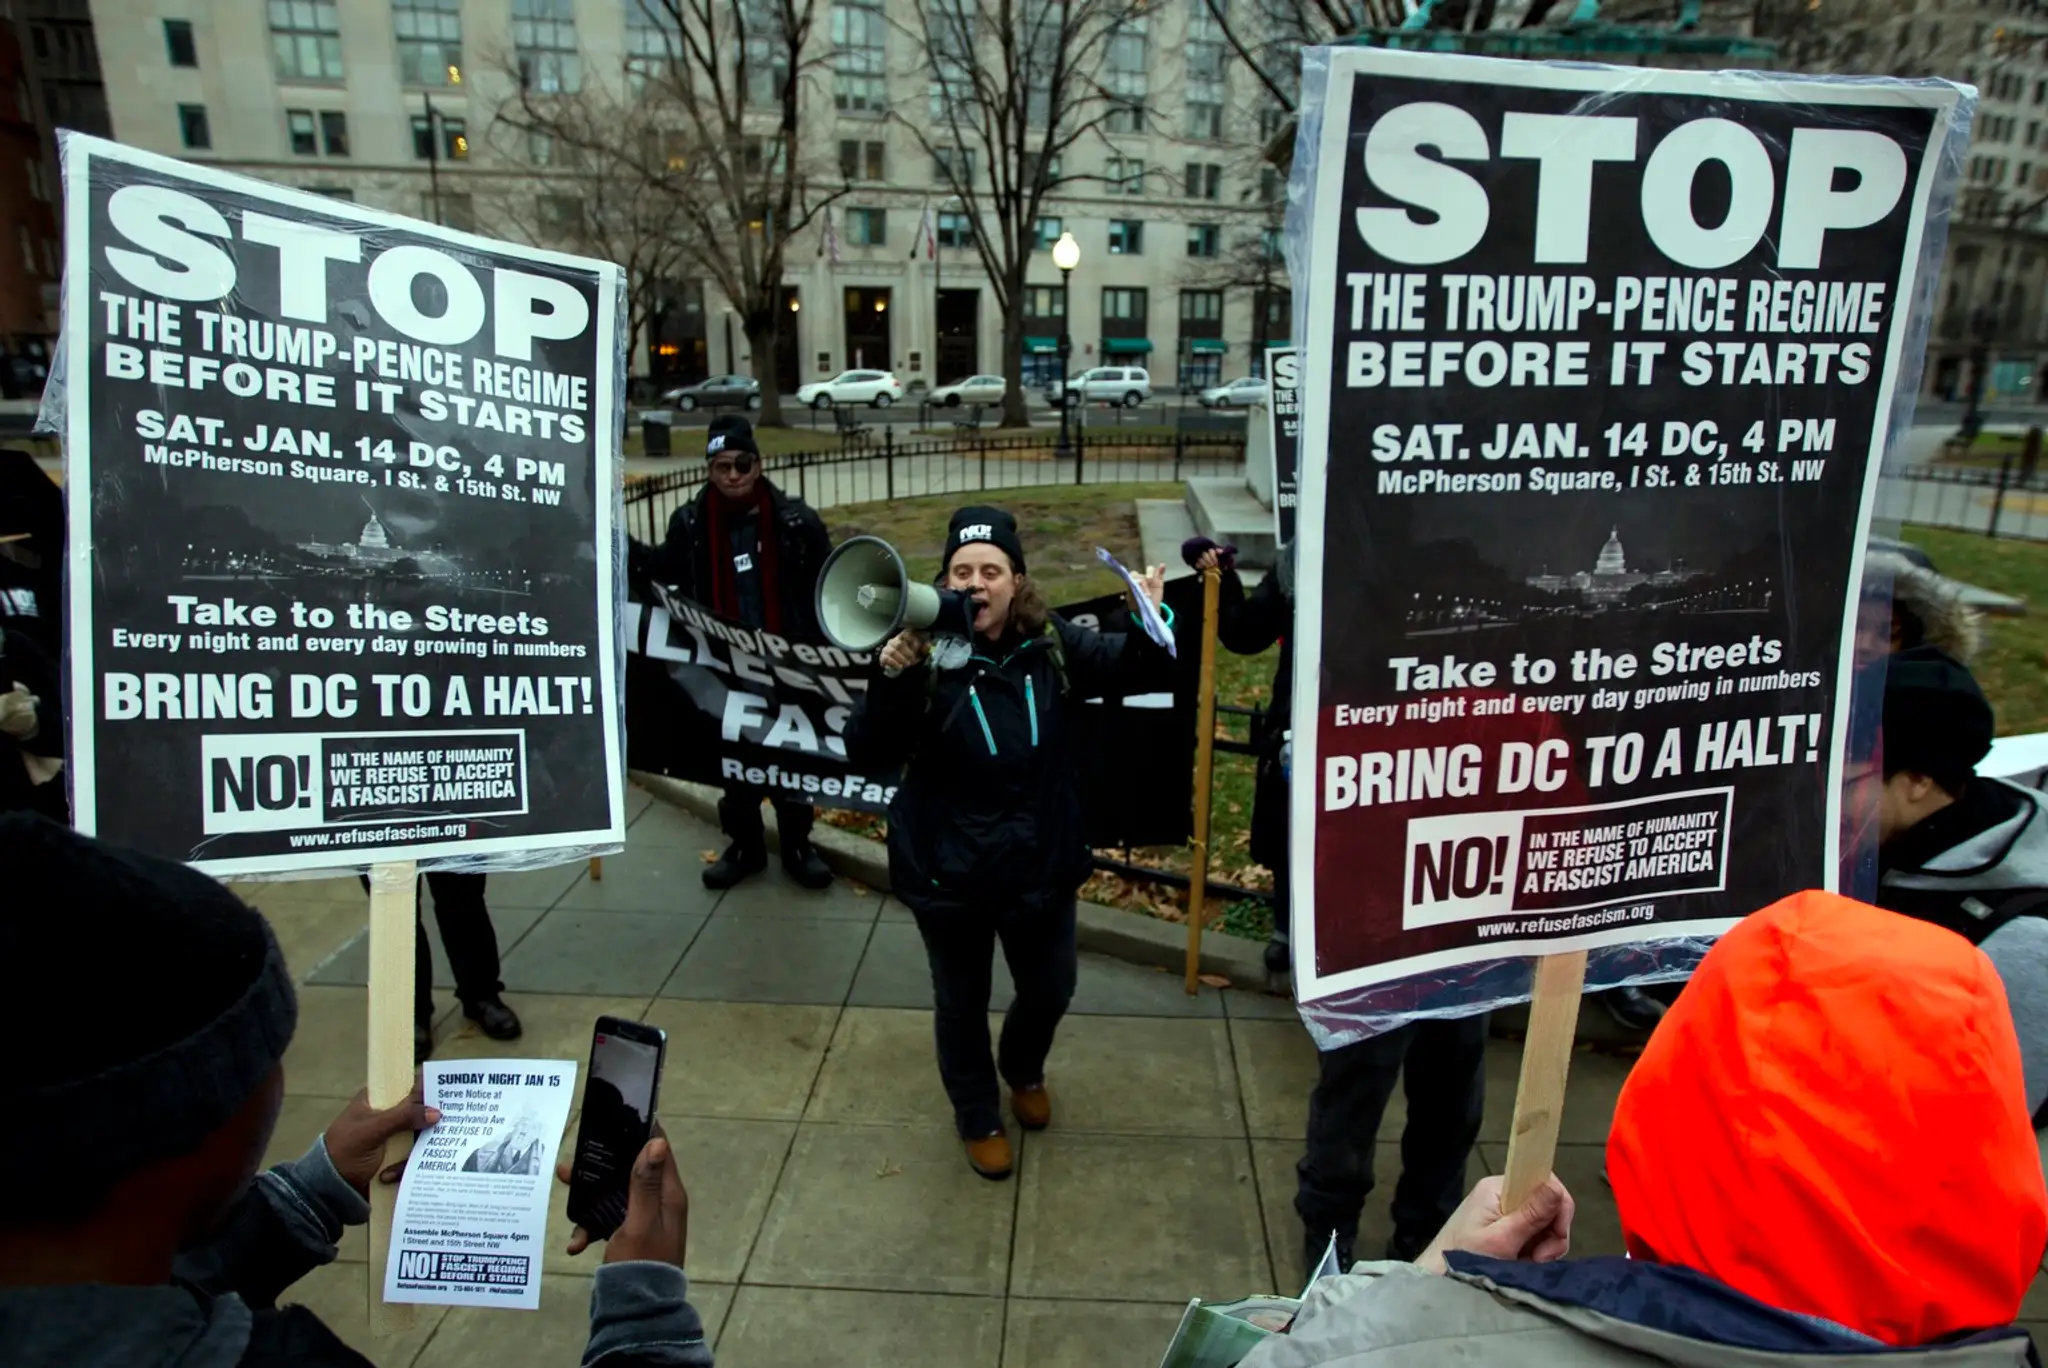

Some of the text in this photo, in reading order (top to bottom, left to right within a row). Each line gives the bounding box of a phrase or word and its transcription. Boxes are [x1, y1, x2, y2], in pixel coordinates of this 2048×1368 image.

[1356, 102, 1906, 270] STOP
[105, 185, 589, 359] STOP
[1347, 273, 1885, 333] THE TRUMP-PENCE REGIME
[100, 291, 586, 410] THE TRUMP-PENCE REGIME
[1347, 341, 1590, 387] BEFORE
[1611, 342, 1665, 385] IT
[1682, 341, 1871, 385] STARTS
[106, 343, 584, 443] BEFORE IT STARTS
[136, 410, 564, 486] SAT. JAN. 14 DC, 4 PM
[1372, 419, 1836, 462] SAT. JAN. 14 DC, 4 PM
[145, 444, 560, 505] McPherson Square, I St. & 15th St. NW
[1378, 460, 1825, 493] McPherson Square, I St. & 15th St. NW
[168, 596, 548, 635] Take to the Streets
[113, 629, 586, 657] Every night and every day growing in numbers
[1389, 635, 1781, 691] Take to the Streets
[105, 673, 592, 719] BRING DC TO A HALT!
[1336, 670, 1820, 726] Every night and every day growing in numbers
[331, 748, 513, 767] IN THE NAME OF HUMANITY
[1325, 714, 1821, 811] BRING DC TO A HALT!
[211, 754, 311, 813] NO!
[331, 763, 514, 786] WE REFUSE TO ACCEPT
[331, 780, 515, 807] A FASCIST AMERICA
[290, 824, 466, 847] www.refusefascism.org
[1530, 811, 1718, 848] IN THE NAME OF HUMANITY
[1528, 829, 1717, 869] WE REFUSE TO ACCEPT
[1411, 835, 1509, 905] NO!
[1523, 850, 1713, 893] A FASCIST AMERICA
[1478, 905, 1654, 937] www.refusefascism.org
[438, 1073, 560, 1087] SUNDAY NIGHT JAN 15
[438, 1090, 502, 1099] Serve Notice at
[439, 1101, 464, 1112] Trump
[466, 1102, 487, 1111] Hotel
[490, 1115, 505, 1124] Ave
[427, 1137, 467, 1147] ACCEPT A
[433, 1126, 493, 1135] WE REFUSE TO
[418, 1161, 457, 1172] AMERICA
[422, 1148, 458, 1158] FASCIST
[404, 1228, 529, 1242] Assemble McPherson Square 4pm
[446, 1239, 460, 1247] 15th
[463, 1240, 485, 1248] Street
[400, 1252, 439, 1279] NO!
[441, 1254, 465, 1262] STOP
[441, 1262, 526, 1274] FASCIST REGIME
[440, 1272, 475, 1281] BEFORE
[488, 1274, 526, 1284] STARTS
